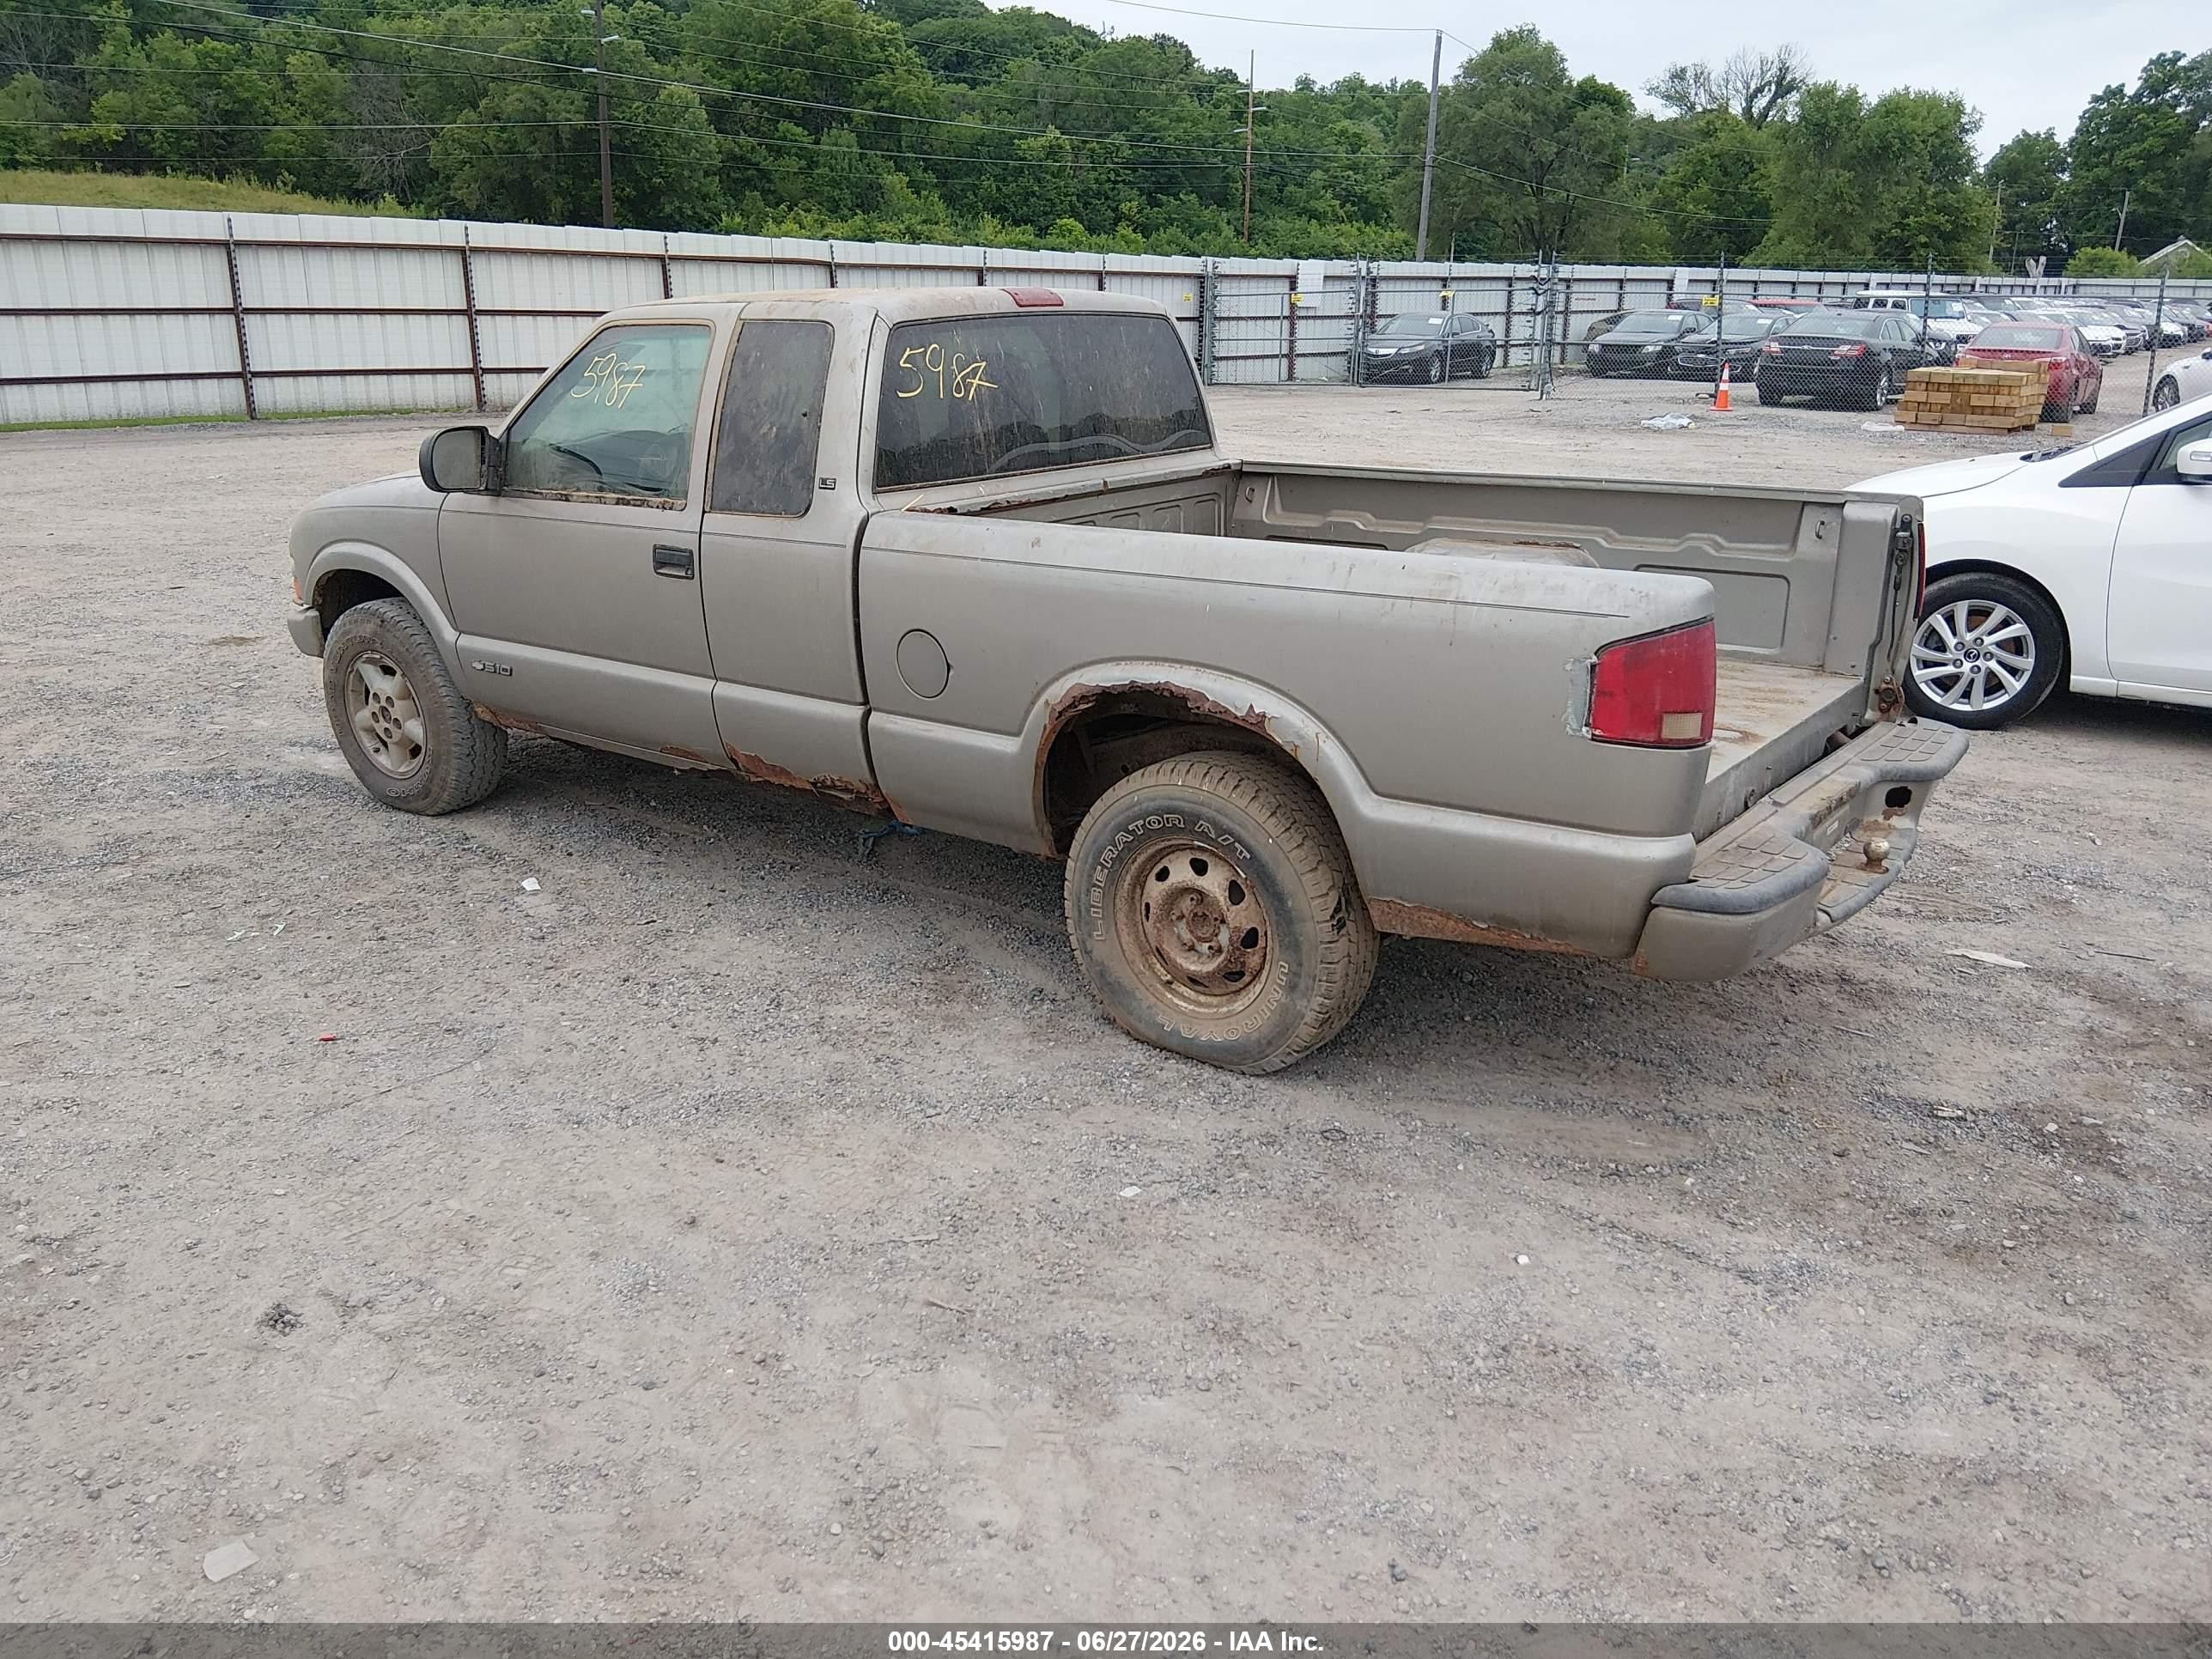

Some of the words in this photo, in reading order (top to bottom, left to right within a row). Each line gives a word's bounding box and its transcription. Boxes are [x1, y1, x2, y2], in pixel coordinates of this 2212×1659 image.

[570, 353, 646, 409] 5987
[896, 343, 999, 401] 5987
[819, 478, 836, 489] LS
[1091, 814, 1185, 940] LIBERATOR
[1194, 820, 1250, 860] A/T
[1157, 961, 1288, 1042] UNIROYAL
